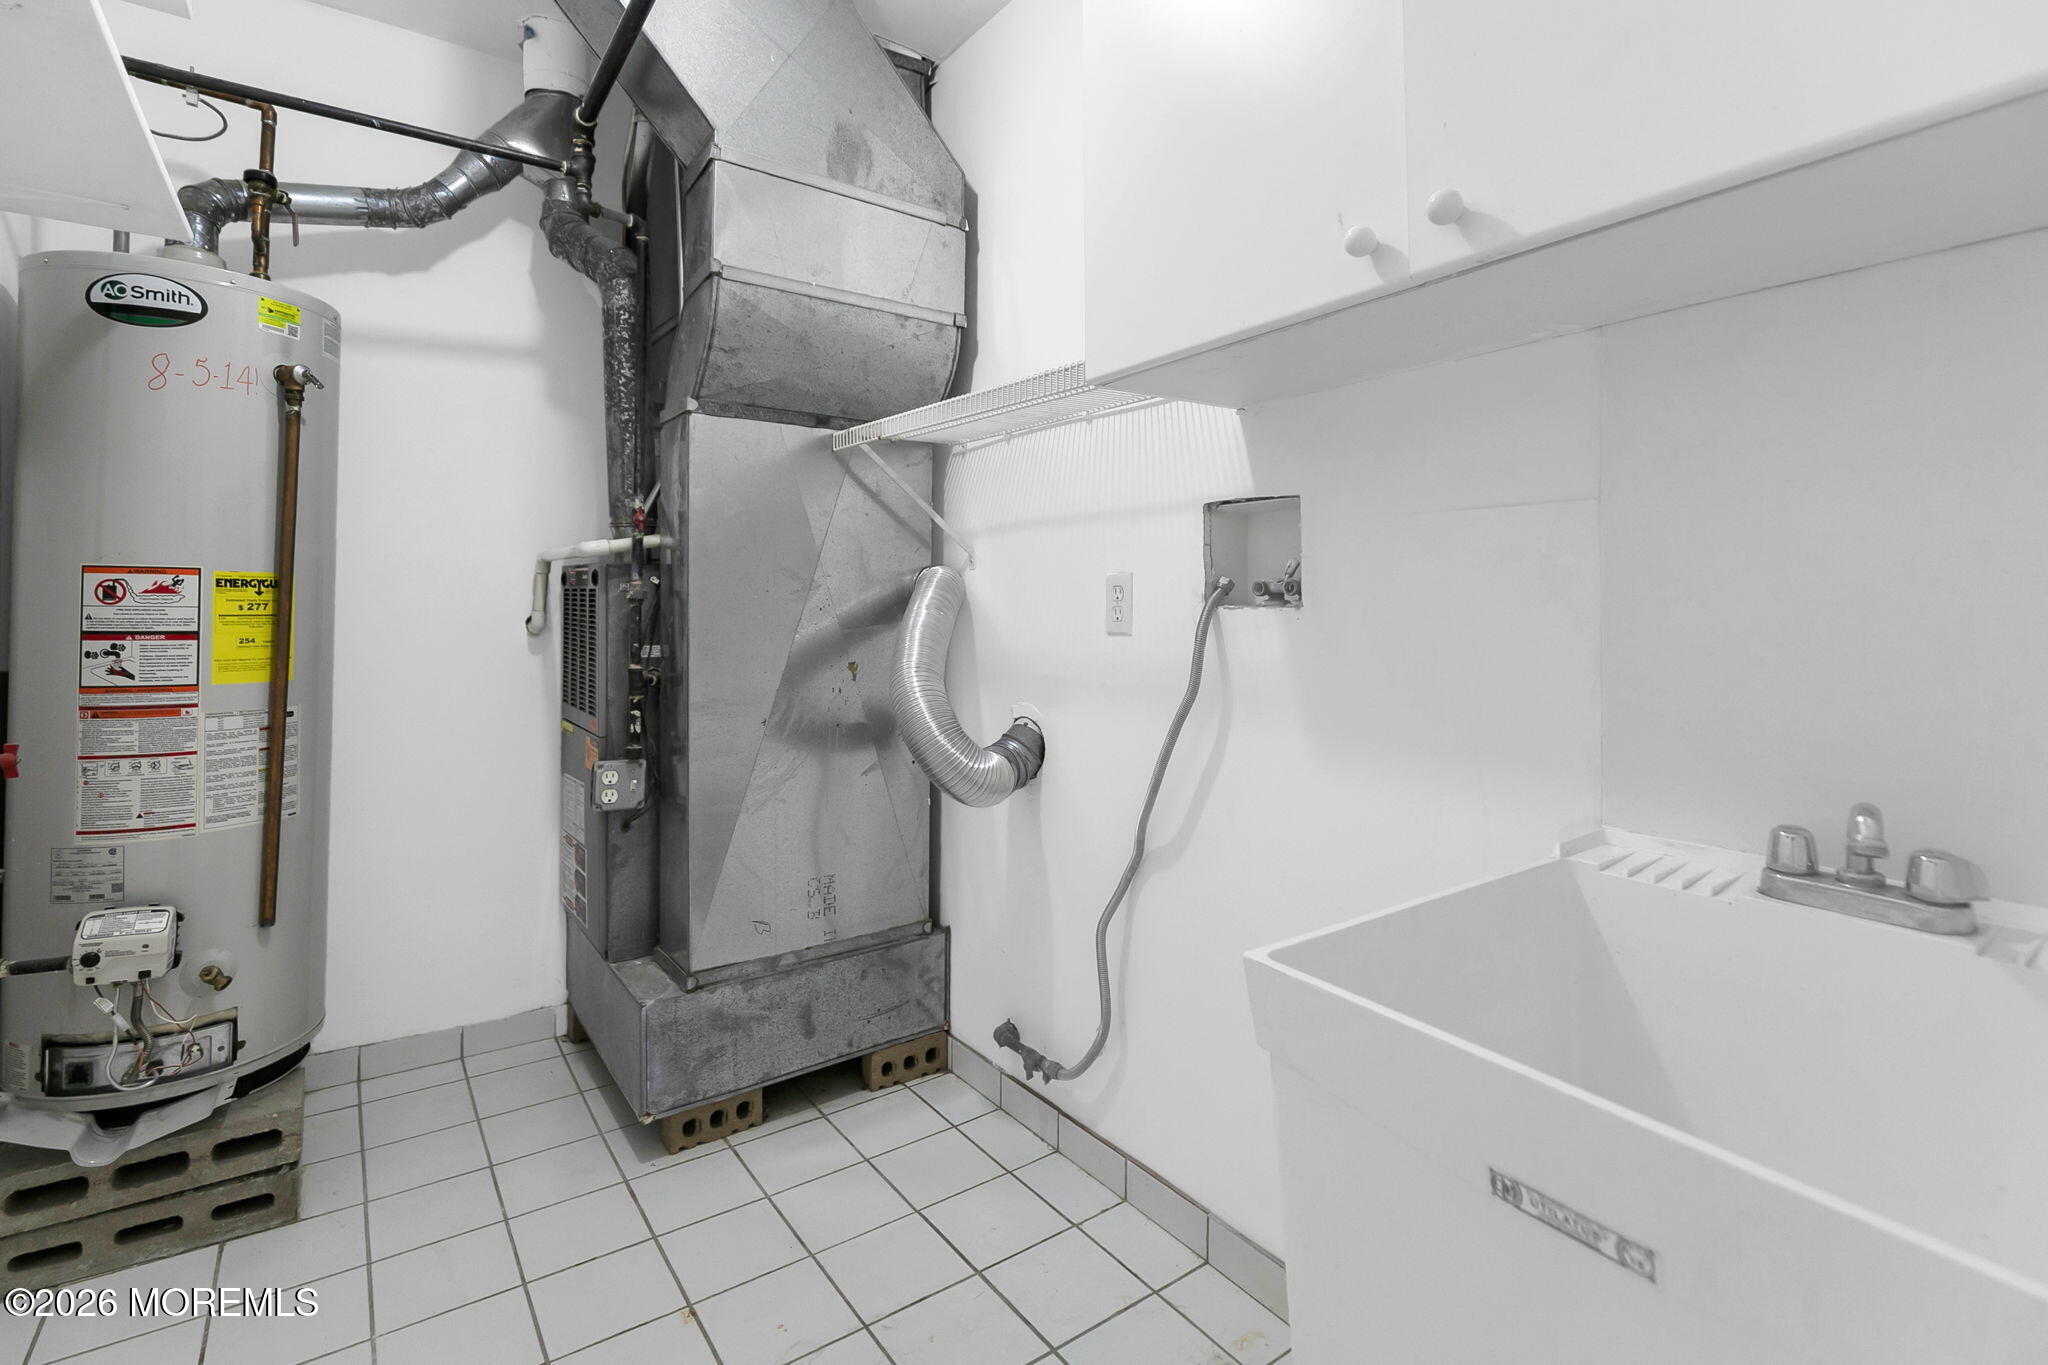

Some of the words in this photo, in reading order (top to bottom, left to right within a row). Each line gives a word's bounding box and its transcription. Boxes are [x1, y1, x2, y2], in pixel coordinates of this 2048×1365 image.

[215, 577, 279, 590] ENERGYGU
[247, 602, 269, 611] 277
[238, 637, 256, 645] 254
